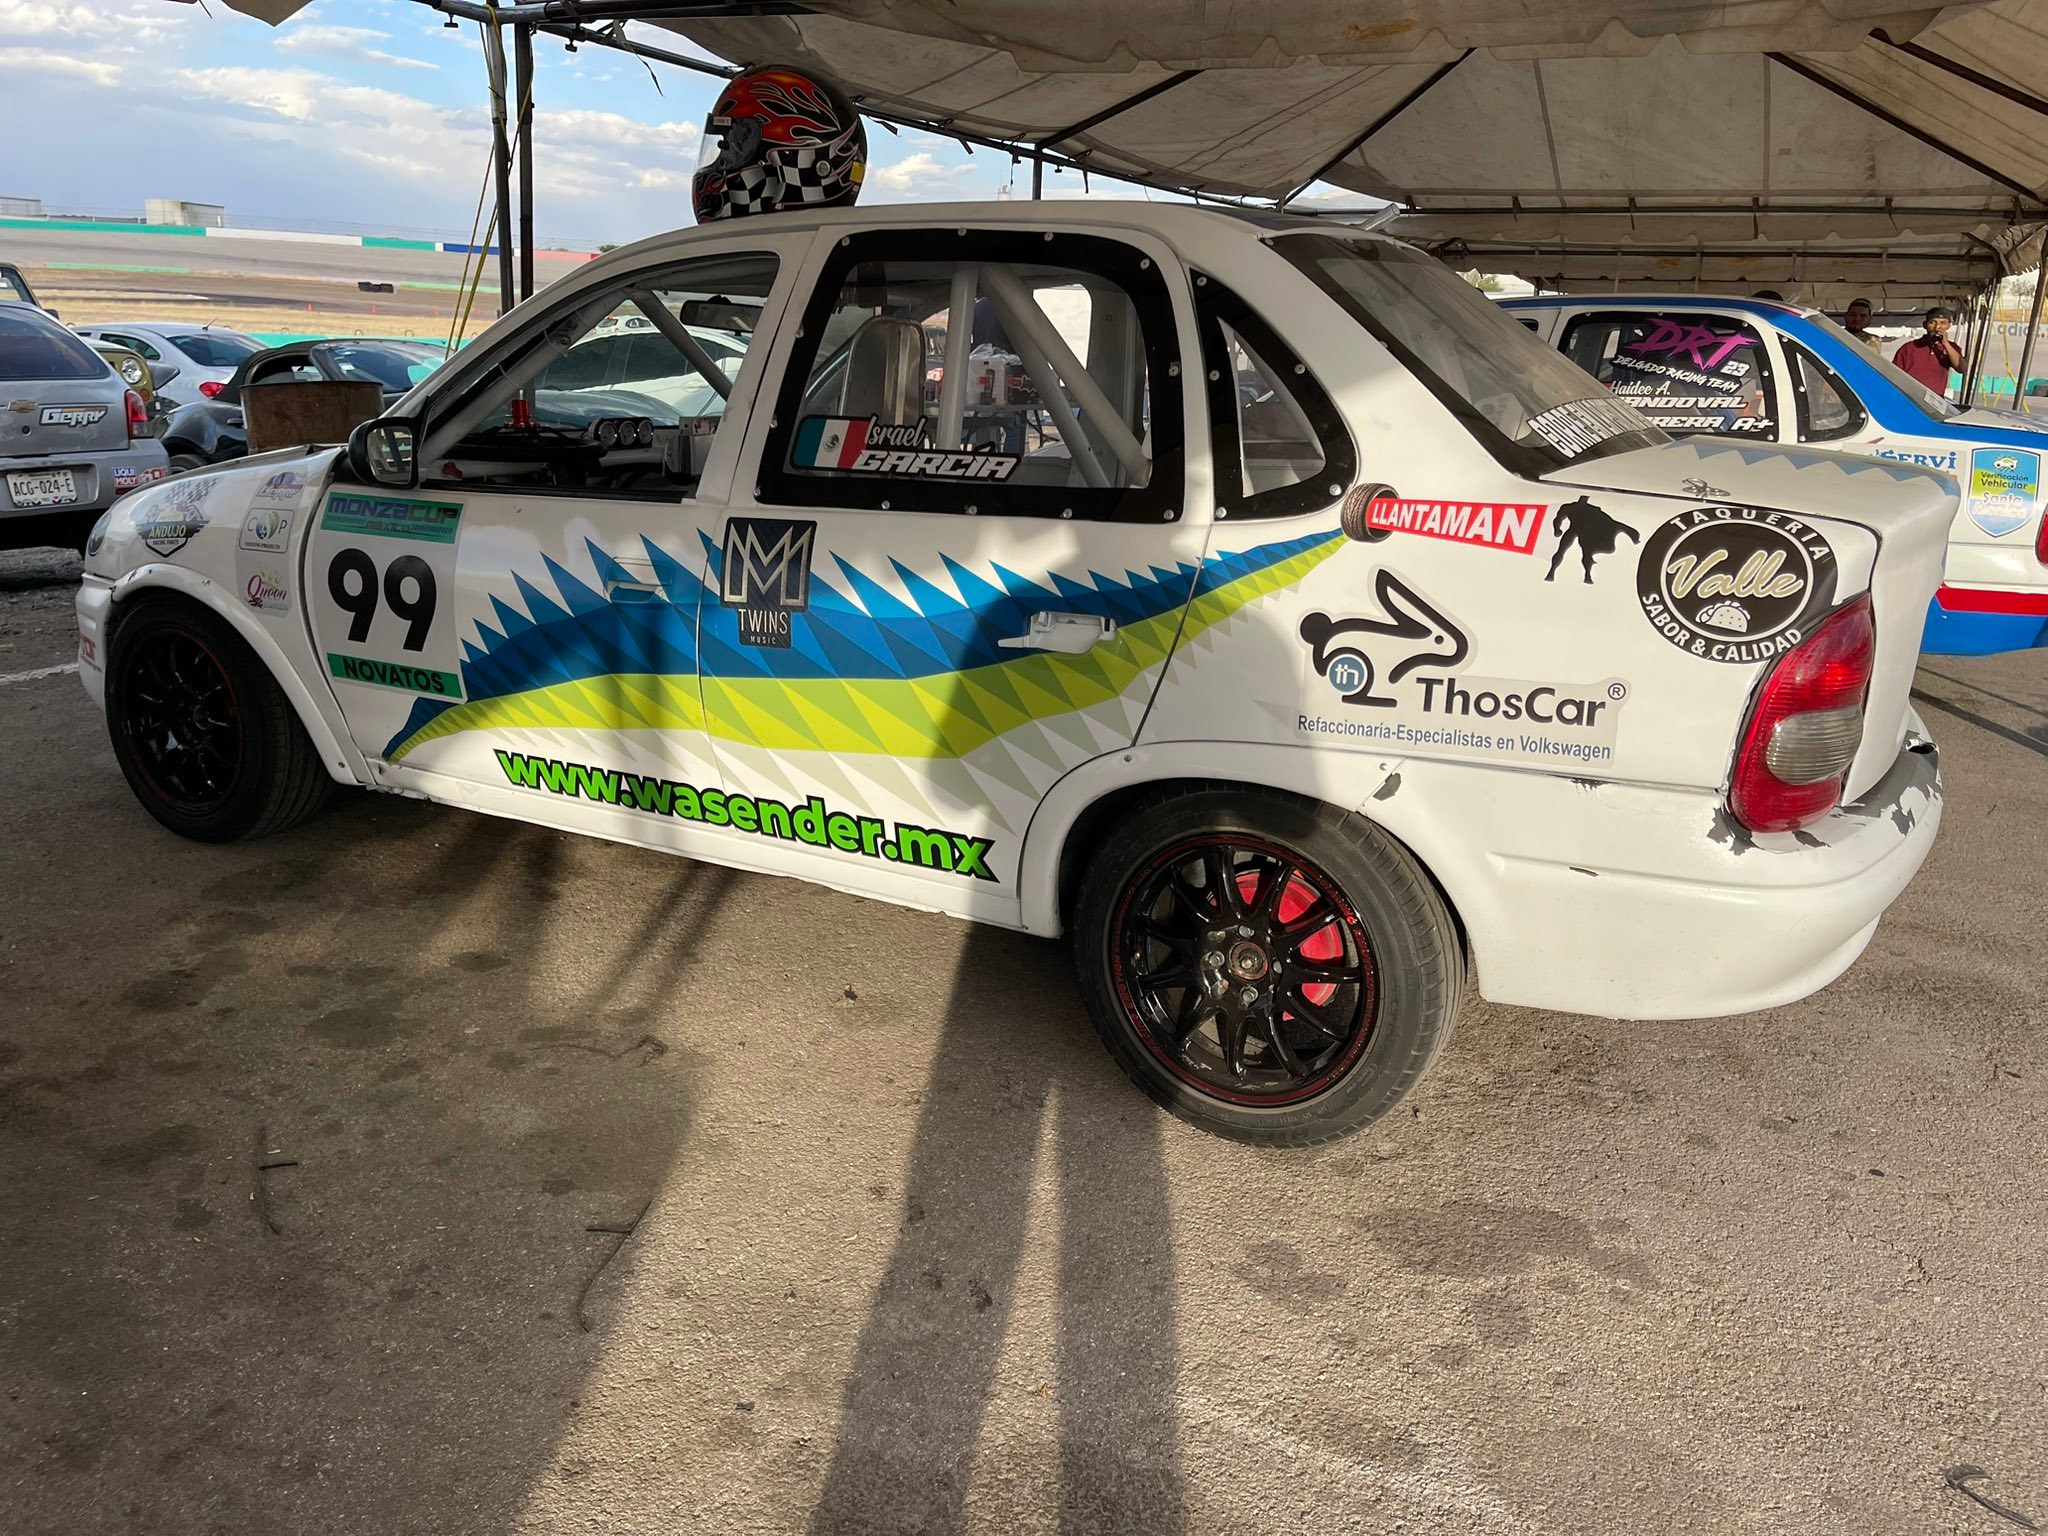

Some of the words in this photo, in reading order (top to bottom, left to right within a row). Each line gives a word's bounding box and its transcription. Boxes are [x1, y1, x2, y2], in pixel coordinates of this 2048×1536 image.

[1624, 318, 1757, 371] DRT
[1612, 355, 1664, 373] DELGADO
[1665, 369, 1707, 386] RACING
[1707, 377, 1740, 393] TEAM
[1720, 360, 1750, 376] 23
[1611, 380, 1653, 396] Haidee
[1655, 380, 1671, 396] A.
[1620, 396, 1748, 408] ANDOVAL
[865, 416, 926, 448] Israel
[1645, 416, 1725, 428] RERA
[13, 478, 74, 496] ACG-024-E
[115, 476, 138, 485] MOLY
[1981, 472, 2029, 482] Verificación
[1981, 479, 2028, 490] Vehicular
[1983, 492, 2022, 505] Santa
[149, 525, 187, 538] ANDUJO
[1372, 502, 1538, 548] LLANTAMAN
[1670, 508, 1830, 561] TAQUERIA
[1667, 549, 1804, 599] Valle
[247, 574, 288, 601] Queen
[328, 548, 437, 652] 99
[738, 608, 788, 635] TWINS
[1642, 593, 1691, 647] SABOR
[1691, 639, 1706, 655] &
[1711, 628, 1802, 661] CALIDAD
[750, 635, 776, 644] MUSIC
[342, 657, 445, 695] NOVATOS
[1497, 737, 1514, 750] en
[1520, 735, 1611, 761] Volkswagen
[494, 749, 999, 882] www.wasender.mx
